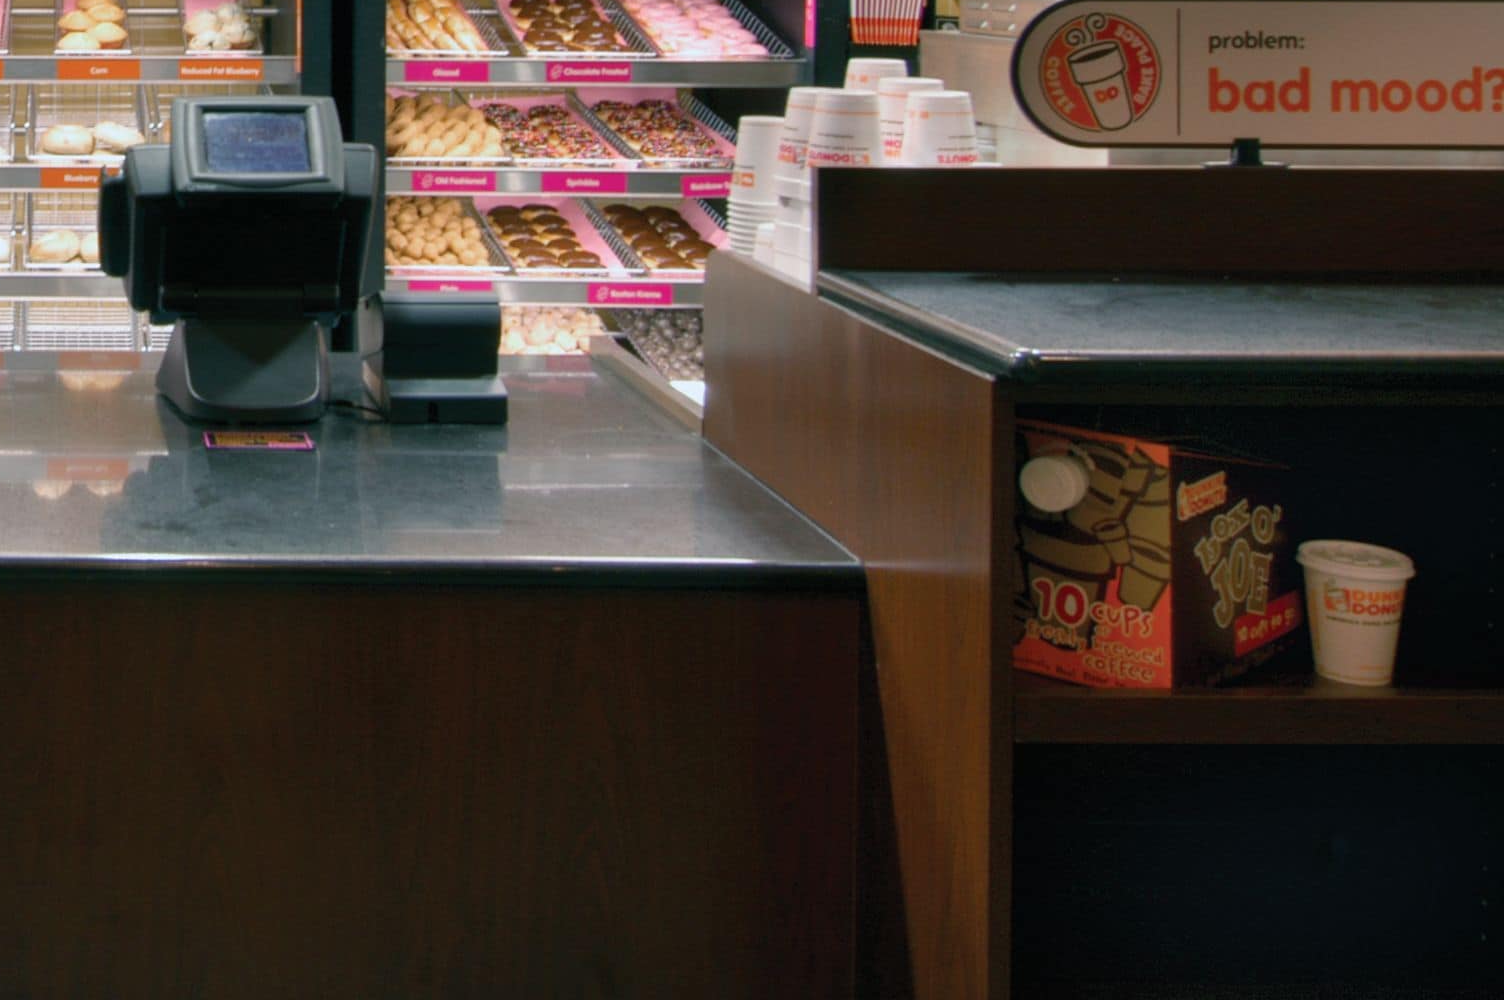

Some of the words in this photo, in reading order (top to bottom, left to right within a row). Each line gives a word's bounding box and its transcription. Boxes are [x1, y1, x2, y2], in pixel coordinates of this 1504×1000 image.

[1208, 32, 1305, 53] problem:
[1208, 67, 1311, 112] bad
[1331, 65, 1504, 112] mood?
[1033, 578, 1087, 625] 10
[1212, 541, 1273, 627] JOE
[1083, 654, 1154, 683] coffee
